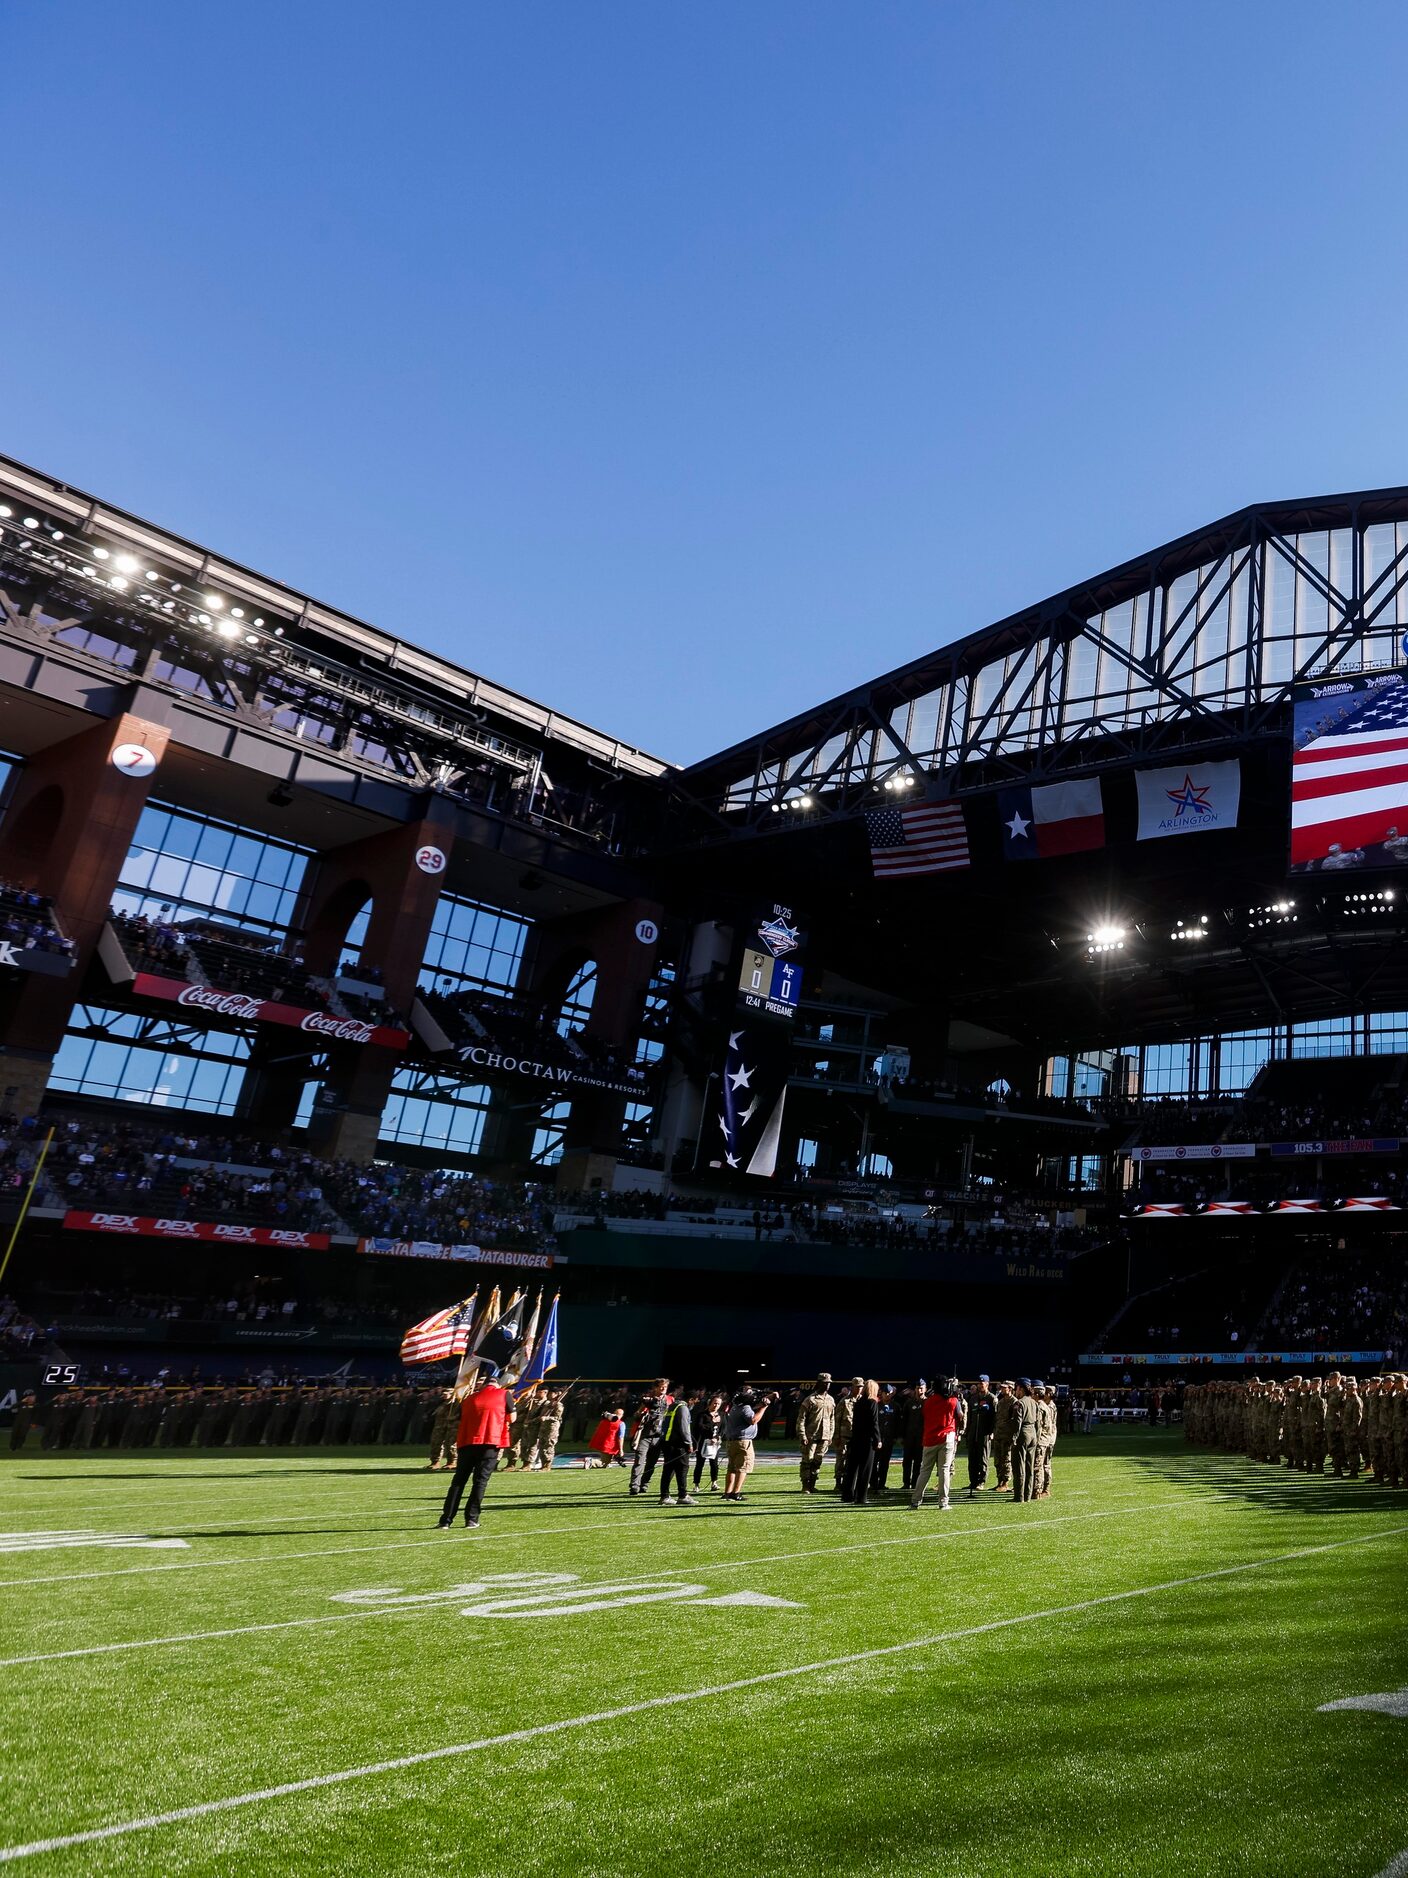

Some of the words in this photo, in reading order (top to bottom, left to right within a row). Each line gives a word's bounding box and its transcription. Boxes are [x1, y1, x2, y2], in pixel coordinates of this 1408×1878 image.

[1322, 682, 1348, 694] ARROW
[124, 751, 144, 769] 7
[1158, 813, 1218, 829] ARLINGTON
[419, 850, 443, 869] 29
[772, 903, 792, 920] 10:25
[640, 924, 653, 940] 10
[751, 969, 762, 989] 0
[780, 979, 791, 999] 0
[177, 984, 265, 1020] Coca-Cola
[745, 995, 761, 1008] 12:41
[765, 1001, 794, 1018] PREGAME
[300, 1010, 380, 1043] Coca-Cola
[470, 1047, 573, 1083] CHOCTAW
[572, 1074, 607, 1088] CASINOS
[614, 1083, 646, 1096] RESORTS
[1294, 1142, 1323, 1154] 105.3
[89, 1212, 139, 1228] DEX
[153, 1218, 201, 1233] DEX
[213, 1223, 257, 1238] DEX
[269, 1229, 310, 1243] DEX
[45, 1366, 78, 1383] 25
